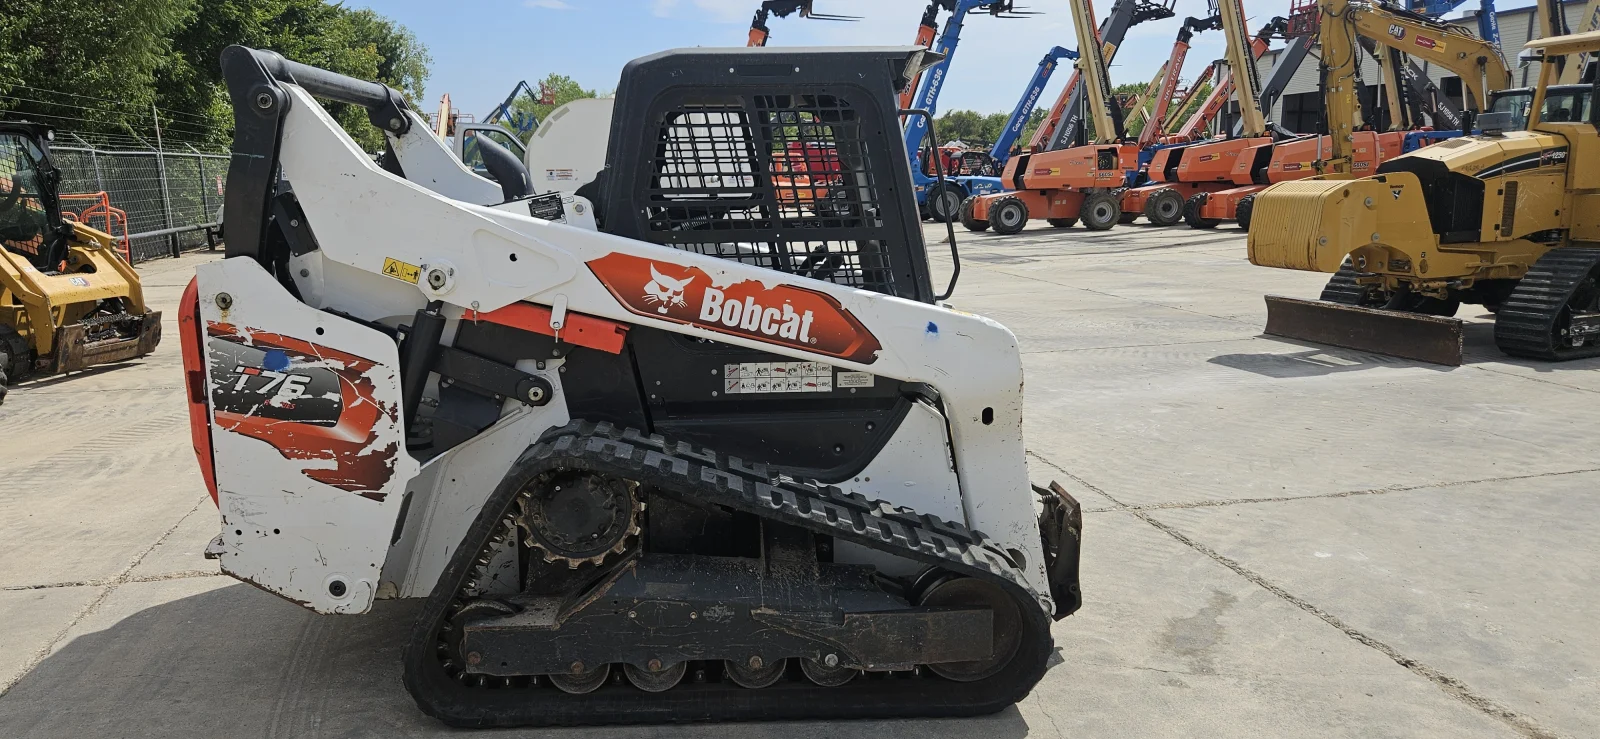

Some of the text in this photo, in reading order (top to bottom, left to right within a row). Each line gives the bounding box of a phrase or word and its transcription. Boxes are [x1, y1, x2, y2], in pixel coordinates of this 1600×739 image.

[1388, 24, 1404, 37] CAT
[1488, 11, 1496, 30] Genie
[925, 68, 943, 106] GTH-636
[1164, 54, 1182, 102] SKYTRAK
[1012, 86, 1040, 132] Genie GTH-636
[699, 286, 814, 343] Bobcat
[233, 365, 313, 397] T76
